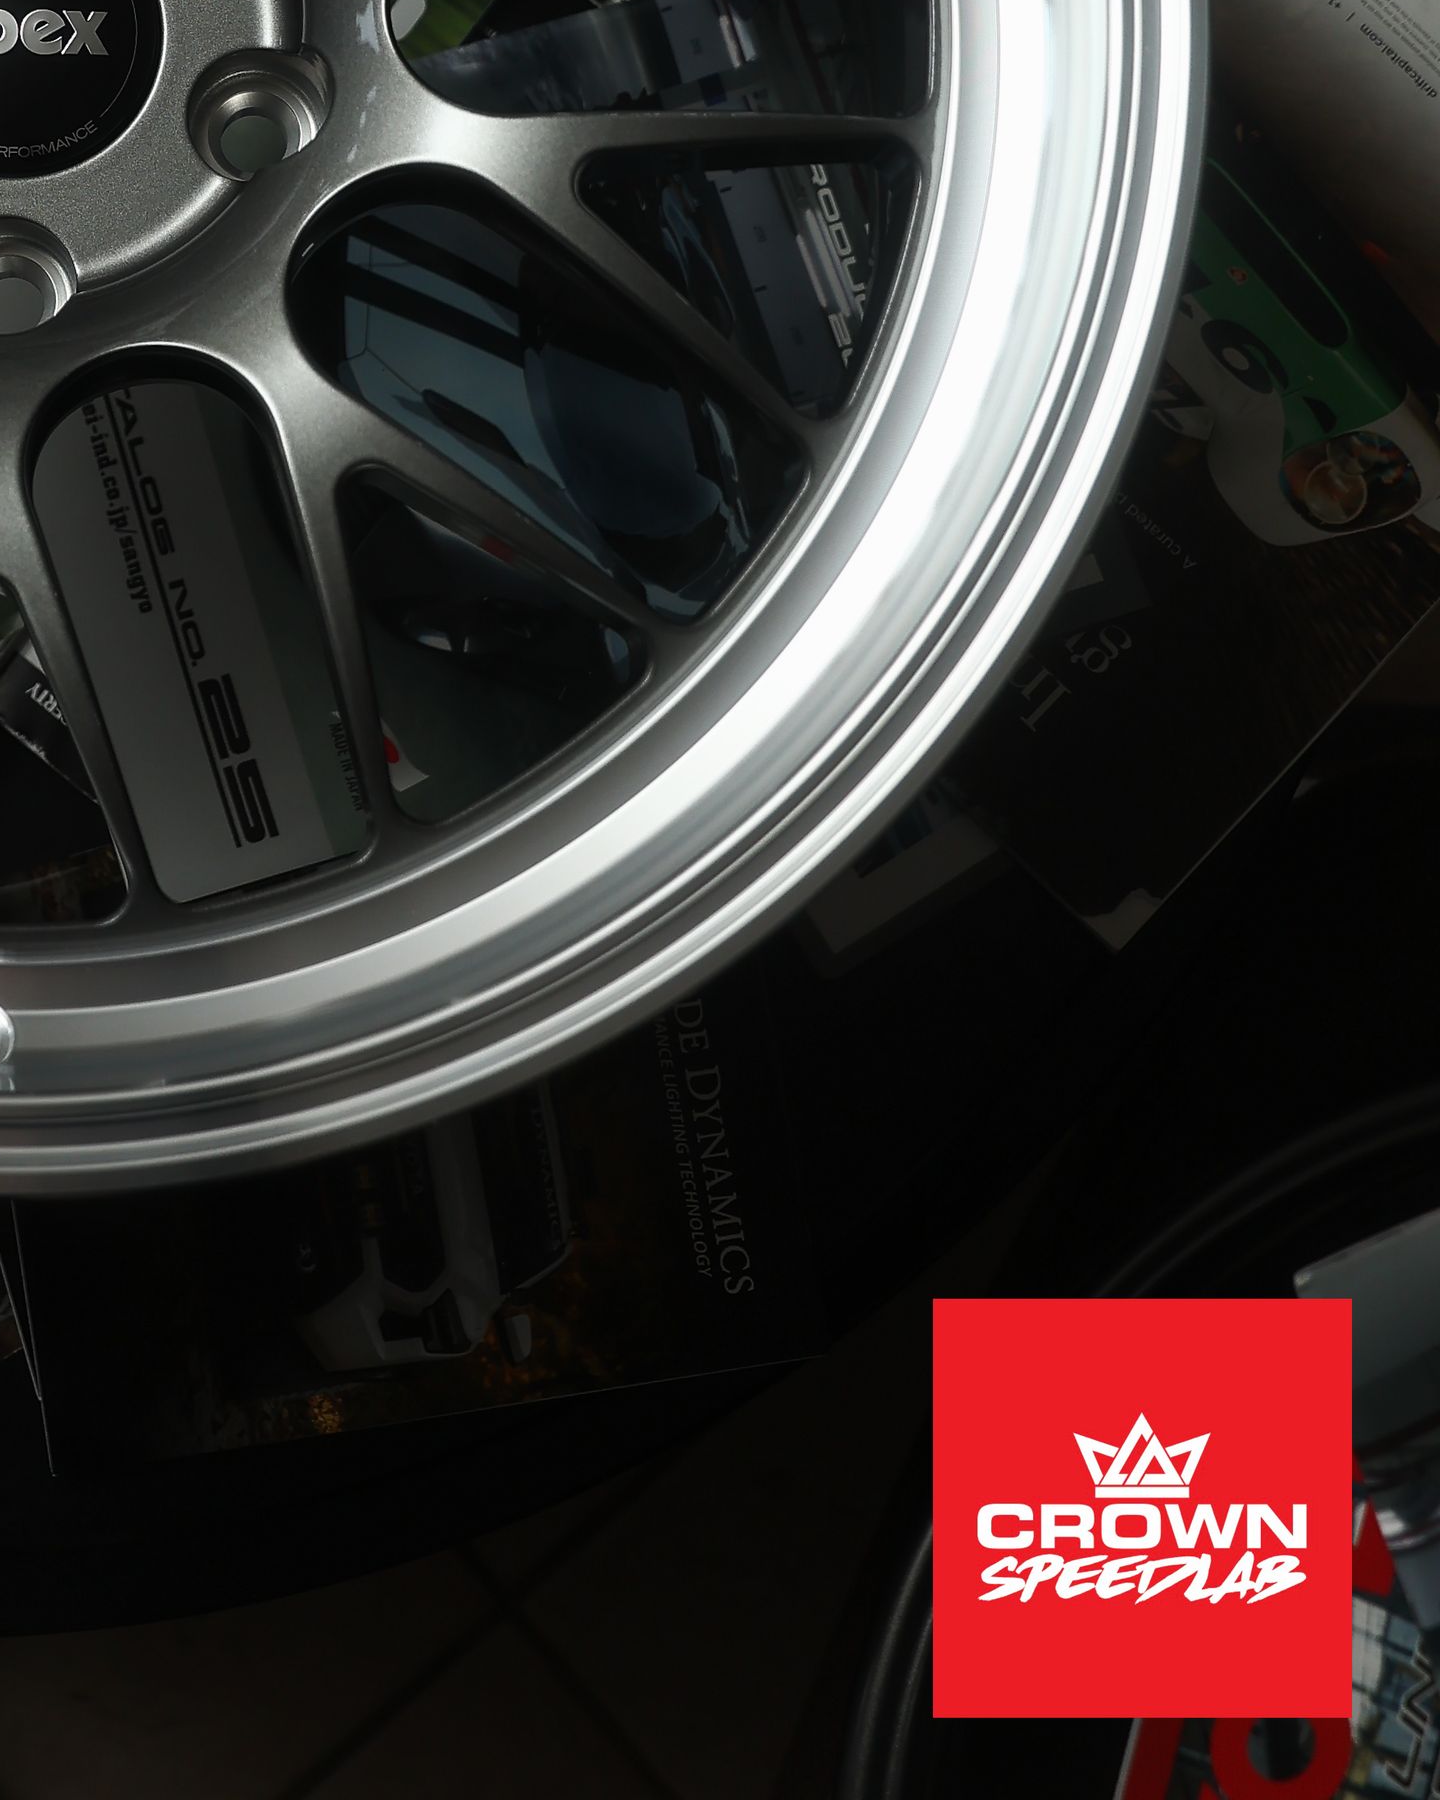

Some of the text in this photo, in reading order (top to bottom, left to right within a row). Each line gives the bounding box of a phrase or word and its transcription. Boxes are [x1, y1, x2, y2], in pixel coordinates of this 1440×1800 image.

[1359, 23, 1438, 100] driftcapital.com
[1123, 503, 1182, 557] curated
[115, 387, 280, 844] ALOG NO. 25
[329, 721, 352, 757] MADE
[341, 756, 355, 773] IN
[656, 1019, 713, 1280] ANCE LIGHTING TECHNOLOGY
[685, 1064, 756, 1296] DYNAMICS
